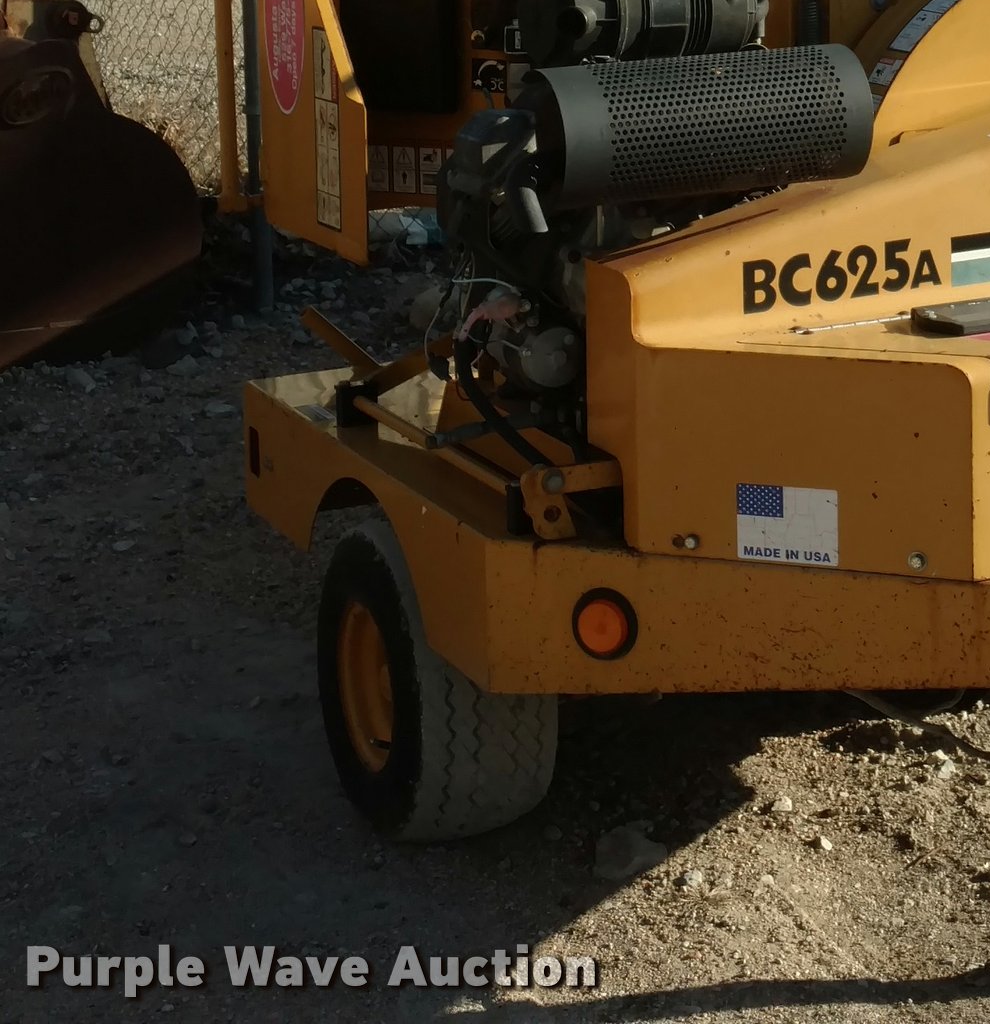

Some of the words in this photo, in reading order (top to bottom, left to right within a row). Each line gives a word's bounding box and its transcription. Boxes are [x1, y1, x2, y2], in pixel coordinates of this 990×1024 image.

[271, 6, 280, 81] Augusta
[742, 238, 942, 314] BC625A
[743, 546, 781, 559] MADE
[785, 549, 799, 560] IN
[803, 551, 831, 563] USA
